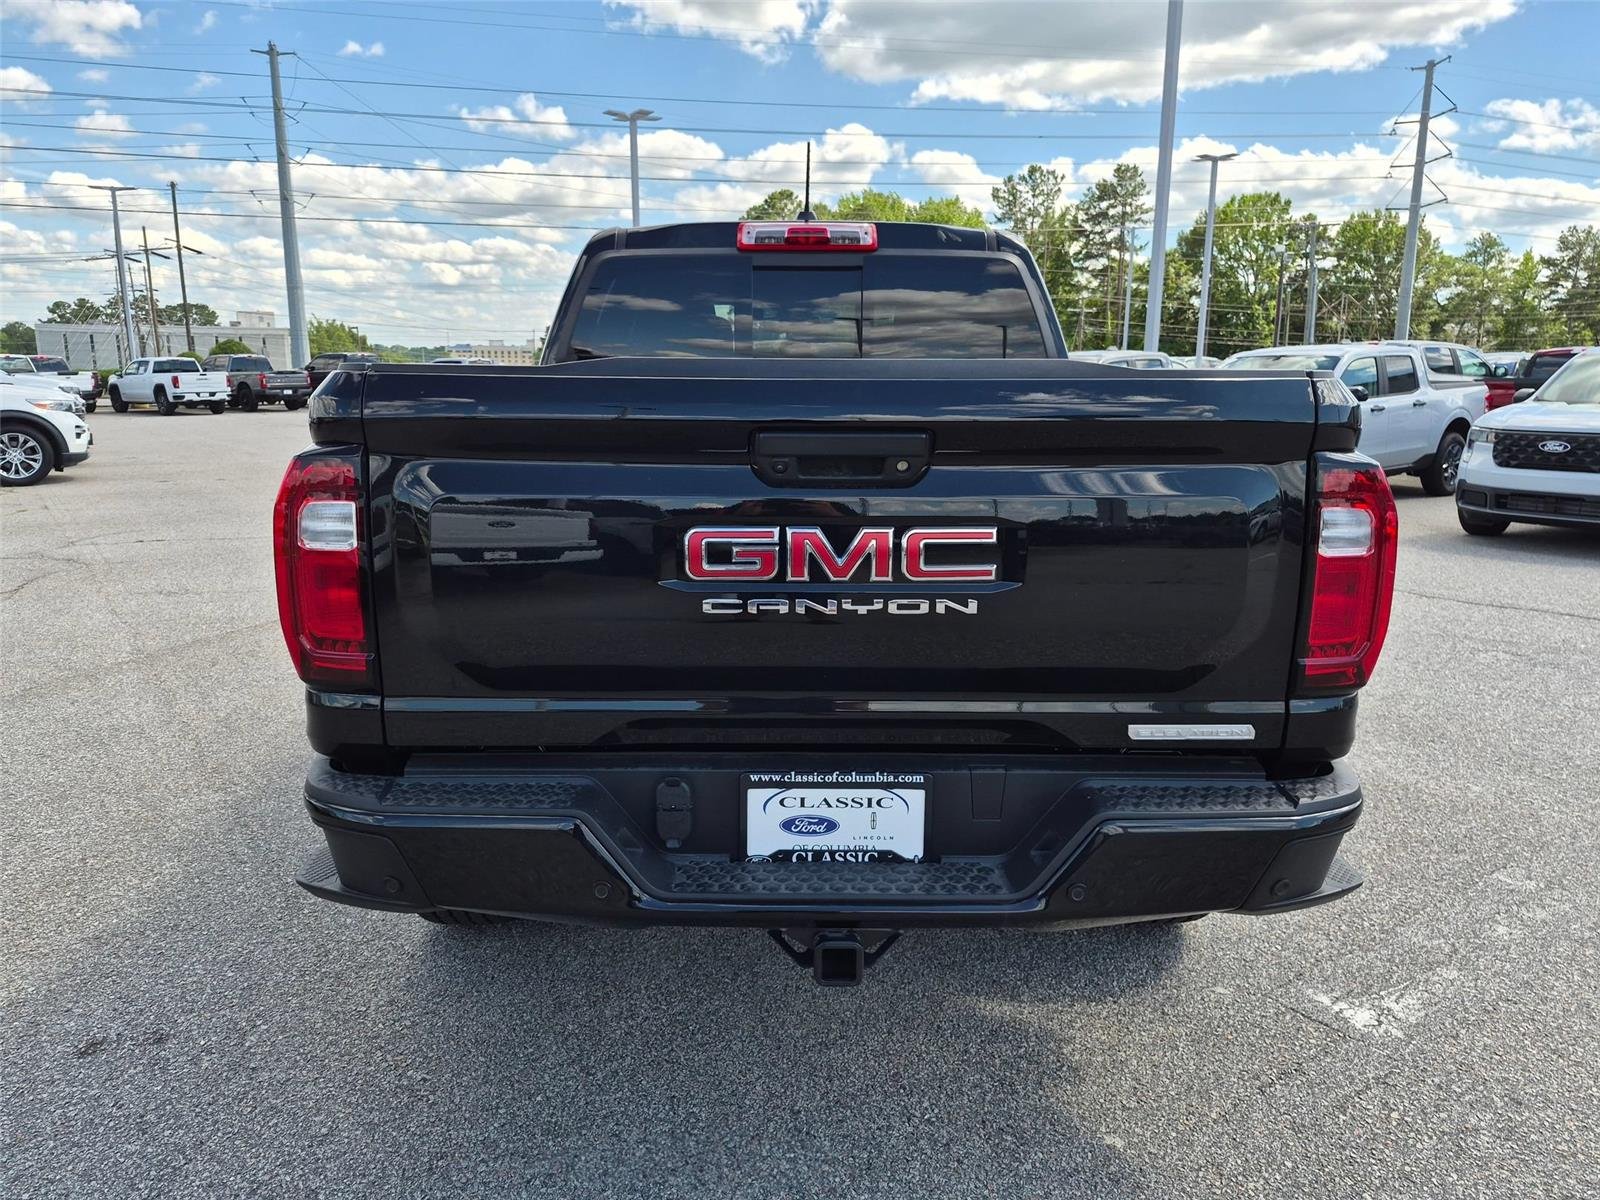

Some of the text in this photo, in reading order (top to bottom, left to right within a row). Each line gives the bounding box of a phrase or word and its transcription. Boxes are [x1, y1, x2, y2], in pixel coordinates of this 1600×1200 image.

[684, 526, 998, 582] GMC
[702, 598, 978, 615] CANYON
[1137, 728, 1245, 736] ELEVATION
[749, 771, 924, 783] www.classicofcolumbia.com
[779, 797, 893, 809] CLASSIC
[791, 817, 828, 833] Ford
[792, 851, 878, 863] CLASSIC
